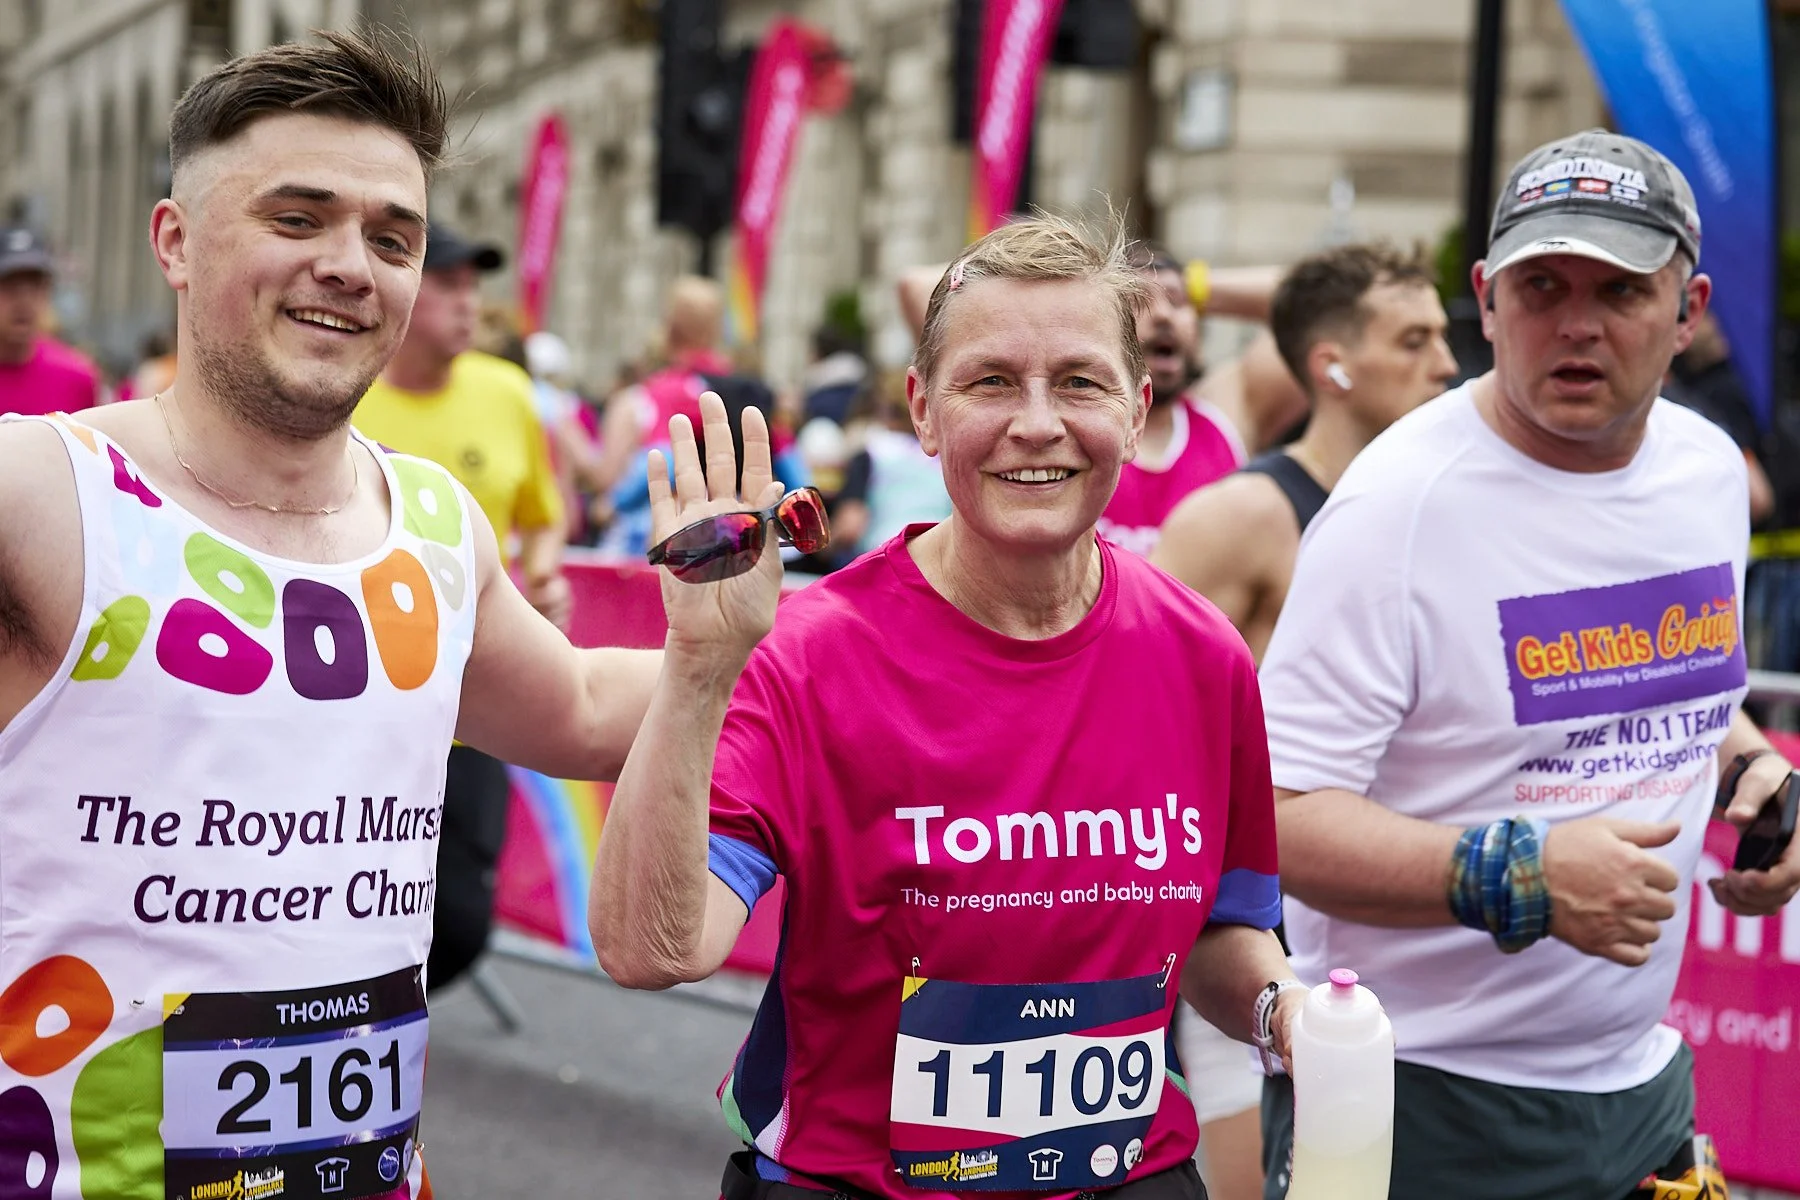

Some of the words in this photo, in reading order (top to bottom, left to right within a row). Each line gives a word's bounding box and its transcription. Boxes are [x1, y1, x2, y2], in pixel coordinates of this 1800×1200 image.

[1516, 631, 1582, 680] Get
[1579, 622, 1654, 671] Kids
[1531, 678, 1566, 697] Sport
[1568, 676, 1578, 691] &
[1579, 670, 1623, 689] Mobility
[1624, 669, 1640, 683] for
[1641, 659, 1686, 682] Disabled
[1687, 654, 1728, 672] Children
[1564, 724, 1610, 750] THE
[1617, 715, 1672, 744] NO.1
[1677, 703, 1732, 737] TEAM
[1514, 782, 1633, 804] SUPPORTING
[77, 795, 181, 847] The
[196, 796, 346, 856] Royal
[895, 793, 1202, 871] Tommy's
[133, 875, 332, 923] Cancer
[900, 888, 940, 908] The
[946, 889, 1053, 912] pregnancy
[1060, 883, 1098, 904] and
[1104, 881, 1153, 904] baby
[1159, 880, 1203, 903] charity
[276, 992, 370, 1025] THOMAS
[1020, 998, 1075, 1018] ANN
[1716, 1006, 1792, 1053] and
[216, 1039, 401, 1134] 2161
[918, 1040, 1153, 1118] 11109
[191, 1180, 232, 1200] LONDON
[245, 1179, 284, 1197] LANDMARKS
[910, 1160, 949, 1176] LONDON
[960, 1162, 998, 1177] LANDMARKS
